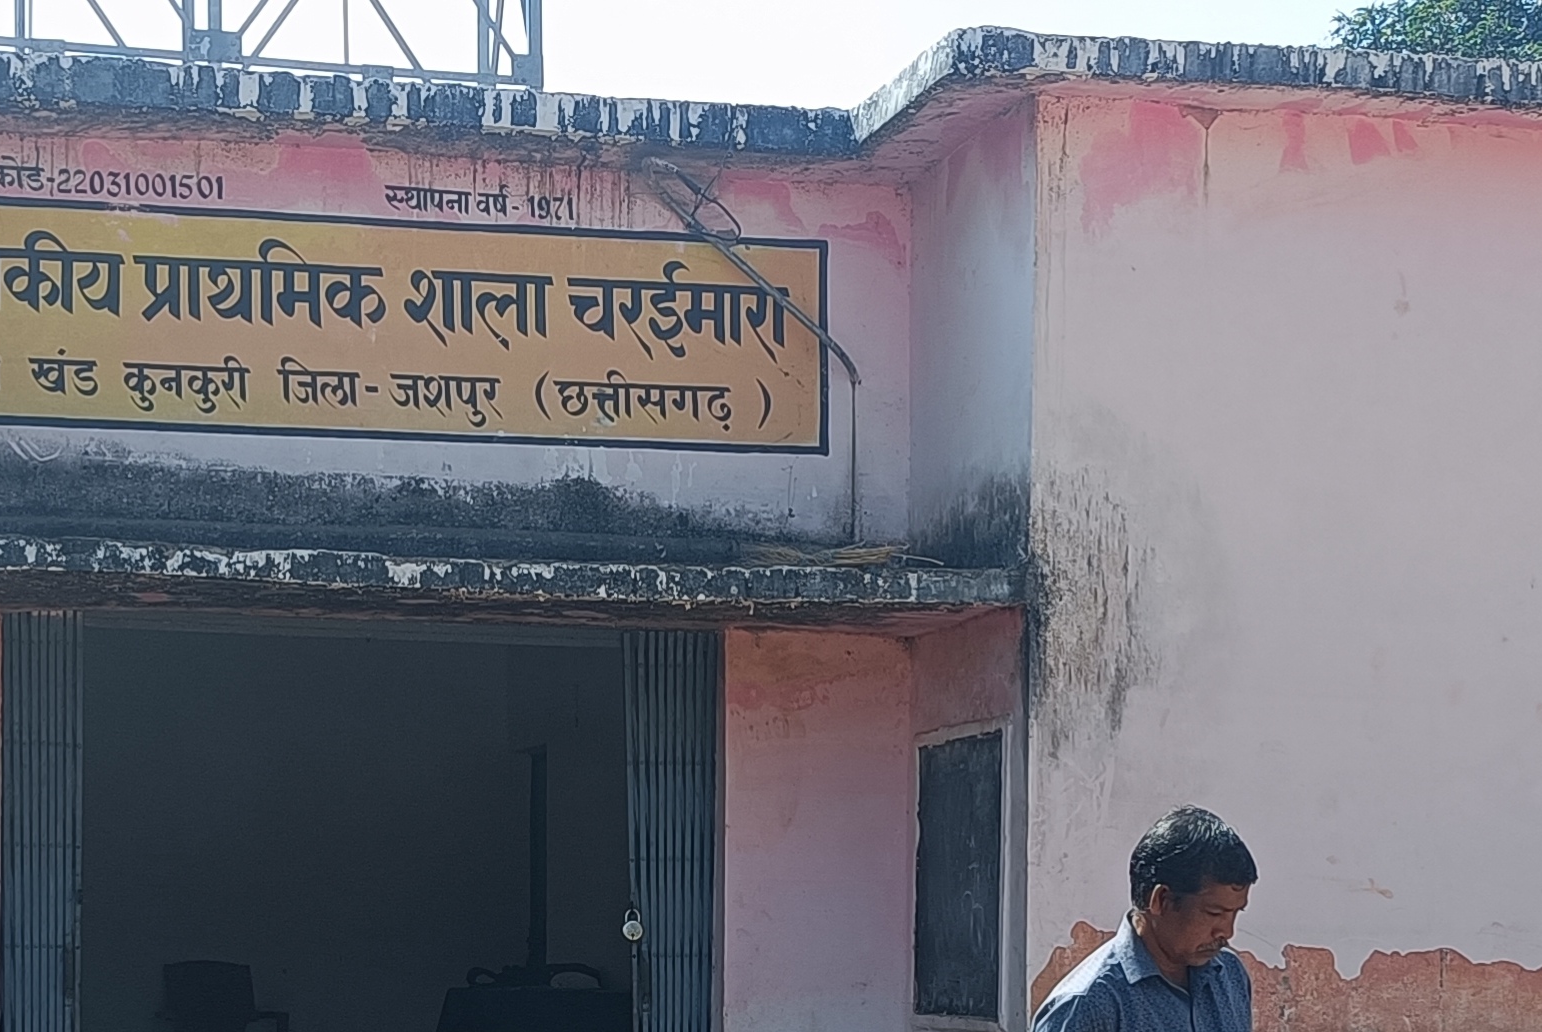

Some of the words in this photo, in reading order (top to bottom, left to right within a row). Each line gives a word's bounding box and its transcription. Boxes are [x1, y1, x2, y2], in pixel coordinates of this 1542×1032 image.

[383, 184, 472, 215] स्थापना
[132, 237, 386, 331] प्राथमिक
[404, 268, 554, 351] शाला
[567, 260, 791, 364] चरईमारा
[27, 347, 100, 396] खंड
[122, 354, 251, 415] कुनकुरी
